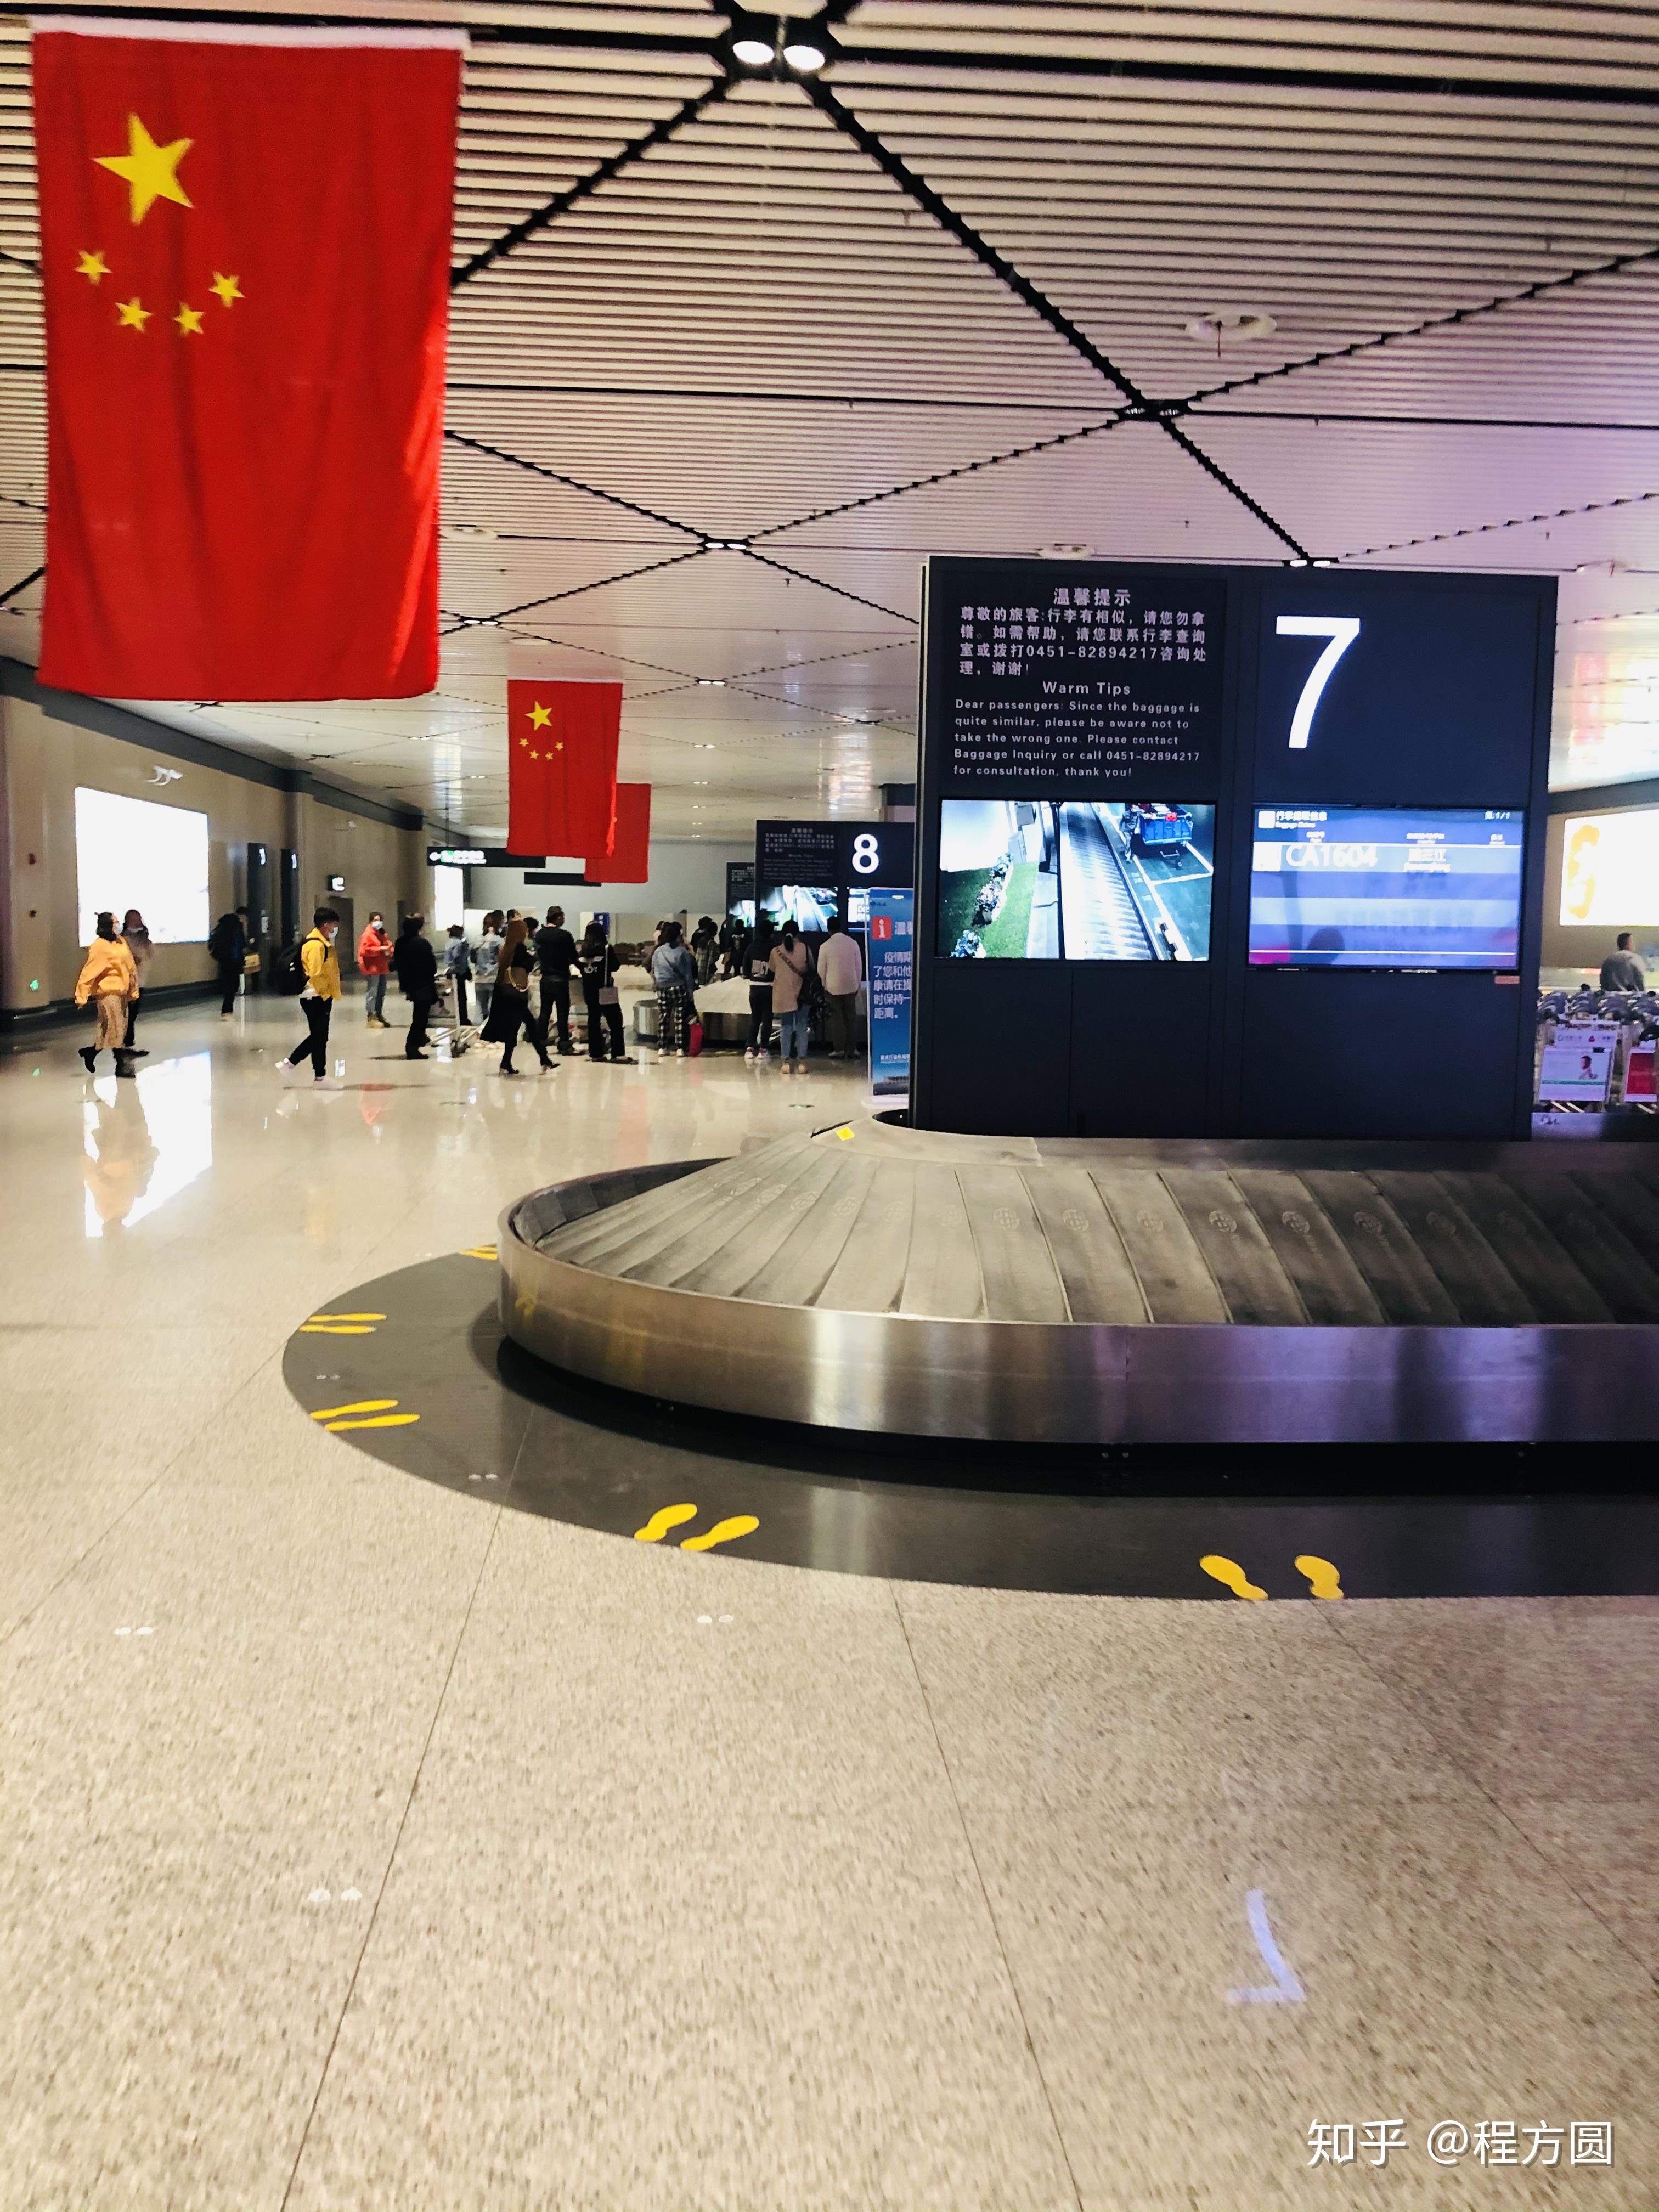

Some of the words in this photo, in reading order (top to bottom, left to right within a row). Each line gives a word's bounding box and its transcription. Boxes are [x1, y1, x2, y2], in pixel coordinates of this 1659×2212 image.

[1053, 588, 1131, 607] 温馨提示
[961, 624, 1205, 644] 错。如需帮助，请您联系行李查询
[960, 642, 1206, 662] 室或拨打0451-82894217咨询处
[1042, 681, 1089, 694] Warm
[1097, 682, 1131, 697] Tips
[1276, 615, 1361, 749] 7
[955, 698, 984, 709] Dear
[989, 701, 1063, 712] passengers:
[1069, 701, 1103, 711] Since
[1108, 702, 1127, 712] the
[1132, 702, 1184, 714] baggage
[1190, 703, 1200, 713] is
[955, 715, 987, 727] quite
[992, 716, 1039, 727] similar,
[1045, 717, 1085, 728] please
[1090, 718, 1104, 727] be
[1152, 720, 1171, 729] not
[1177, 720, 1189, 729] to
[955, 732, 981, 742] take
[986, 732, 1006, 742] the
[1012, 735, 1051, 745] wrong
[1088, 733, 1127, 744] Please
[1132, 736, 1178, 745] contact
[954, 748, 1008, 761] Baggage
[1013, 749, 1057, 761] Inquiry
[1080, 751, 1101, 760] call
[1107, 751, 1200, 761] 0451-82894217
[953, 765, 972, 775] for
[976, 766, 1059, 776] consultation,
[1065, 766, 1099, 776] thank
[1105, 767, 1131, 778] you!
[851, 833, 879, 874] 8
[1286, 845, 1378, 867] CA1604
